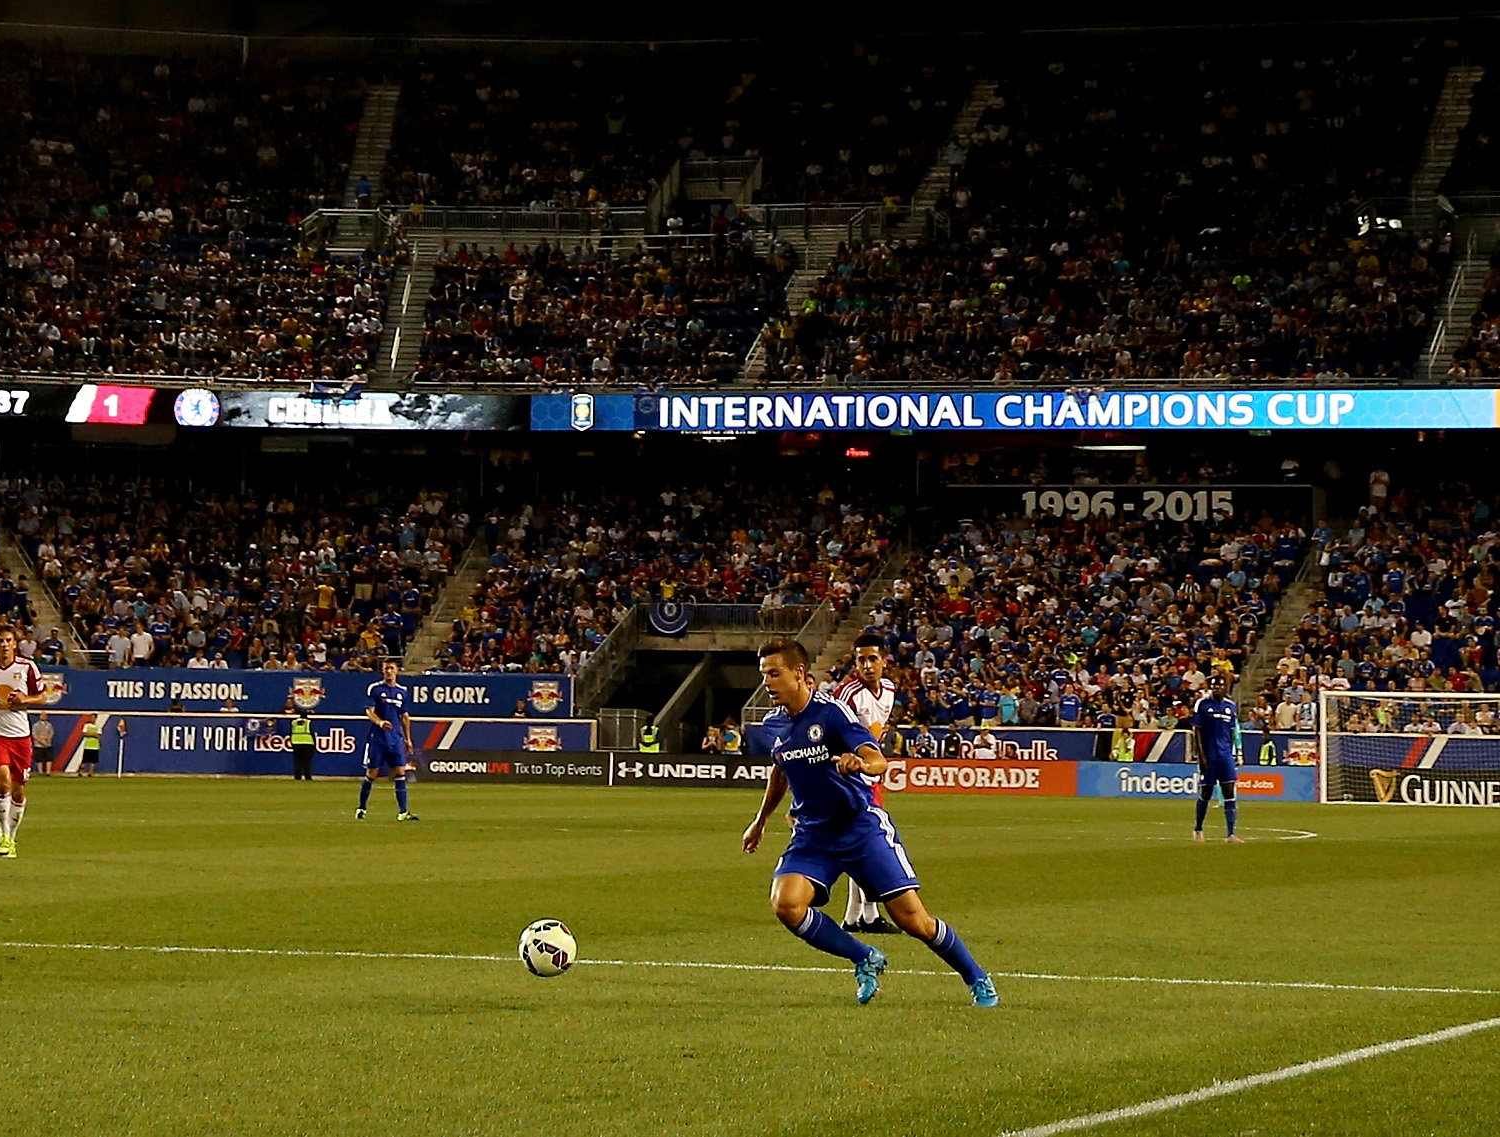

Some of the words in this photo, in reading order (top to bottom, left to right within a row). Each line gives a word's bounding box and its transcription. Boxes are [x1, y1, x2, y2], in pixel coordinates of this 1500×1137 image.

[102, 394, 118, 418] 1
[268, 396, 393, 425] CHELSEA
[658, 394, 983, 429] INTERNATIONAL
[994, 393, 1254, 427] CHAMPIONS
[1266, 393, 1355, 427] CUP
[1022, 490, 1116, 521] 1996
[1142, 490, 1234, 522] 2015
[106, 680, 145, 699] THIS
[149, 681, 166, 700] IS
[170, 682, 249, 701] PASSION.
[413, 685, 430, 704] IS
[432, 686, 491, 704] GLORY.
[160, 725, 196, 751] NEW
[202, 725, 248, 752] YORK
[780, 744, 829, 762] YOKOHAMA
[514, 762, 530, 775] Tix
[531, 764, 543, 775] to
[545, 763, 566, 777] Top
[567, 763, 603, 776] Events
[647, 763, 727, 779] UNDER
[732, 765, 771, 780] AR
[909, 765, 1041, 789] GATORADE
[1117, 766, 1198, 795] indeed
[1252, 779, 1275, 790] Jobs
